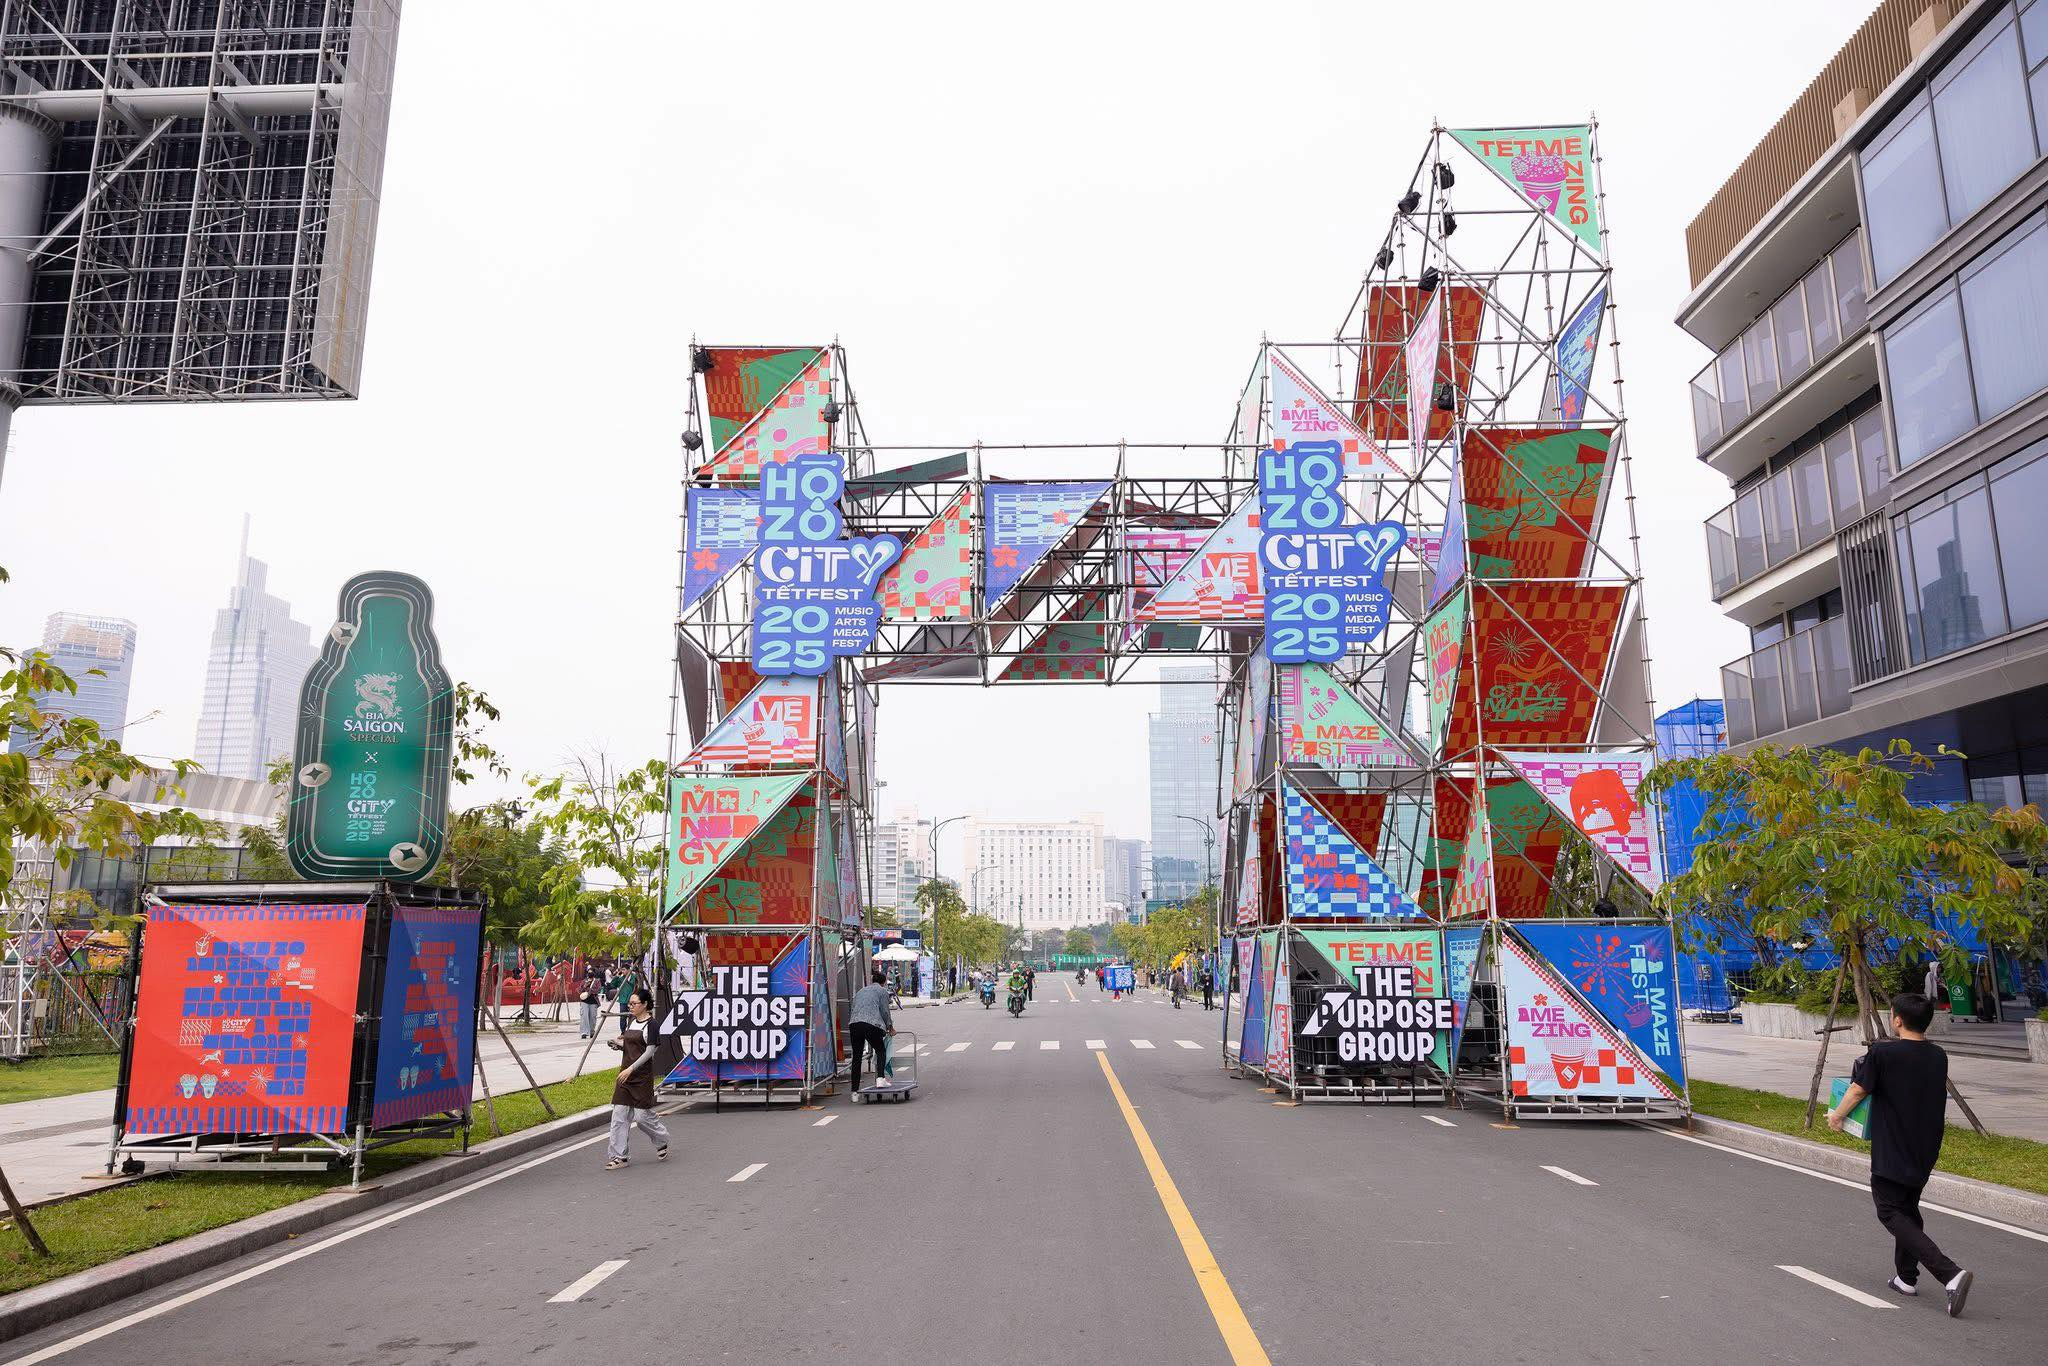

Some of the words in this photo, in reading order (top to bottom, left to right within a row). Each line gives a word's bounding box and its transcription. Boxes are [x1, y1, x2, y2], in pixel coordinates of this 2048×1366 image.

[1292, 421, 1338, 431] ZING
[1345, 593, 1384, 602] MUSIC
[835, 607, 873, 615] MUSIC
[1271, 593, 1340, 621] 20
[1346, 604, 1377, 613] ARTS
[760, 605, 829, 634] 20
[835, 618, 866, 626] ARTS
[1345, 615, 1381, 624] MEGA
[833, 629, 869, 637] MEGA
[1345, 626, 1374, 634] FEST
[832, 640, 862, 648] FEST
[1272, 628, 1340, 656] 25
[758, 640, 826, 668] 25
[366, 712, 384, 720] BIA
[343, 719, 404, 733] SAIGON
[350, 733, 399, 743] SPECIAL
[346, 820, 372, 830] 20
[345, 831, 370, 841] 25
[678, 840, 729, 865] GY
[712, 966, 769, 995] THE
[1354, 967, 1412, 997] THE
[660, 991, 805, 1033] PURPOSE
[1301, 993, 1453, 1034] PURPOSE
[1532, 1023, 1591, 1037] ZING
[691, 1030, 787, 1060] GROUP
[1338, 1031, 1435, 1061] GROUP
